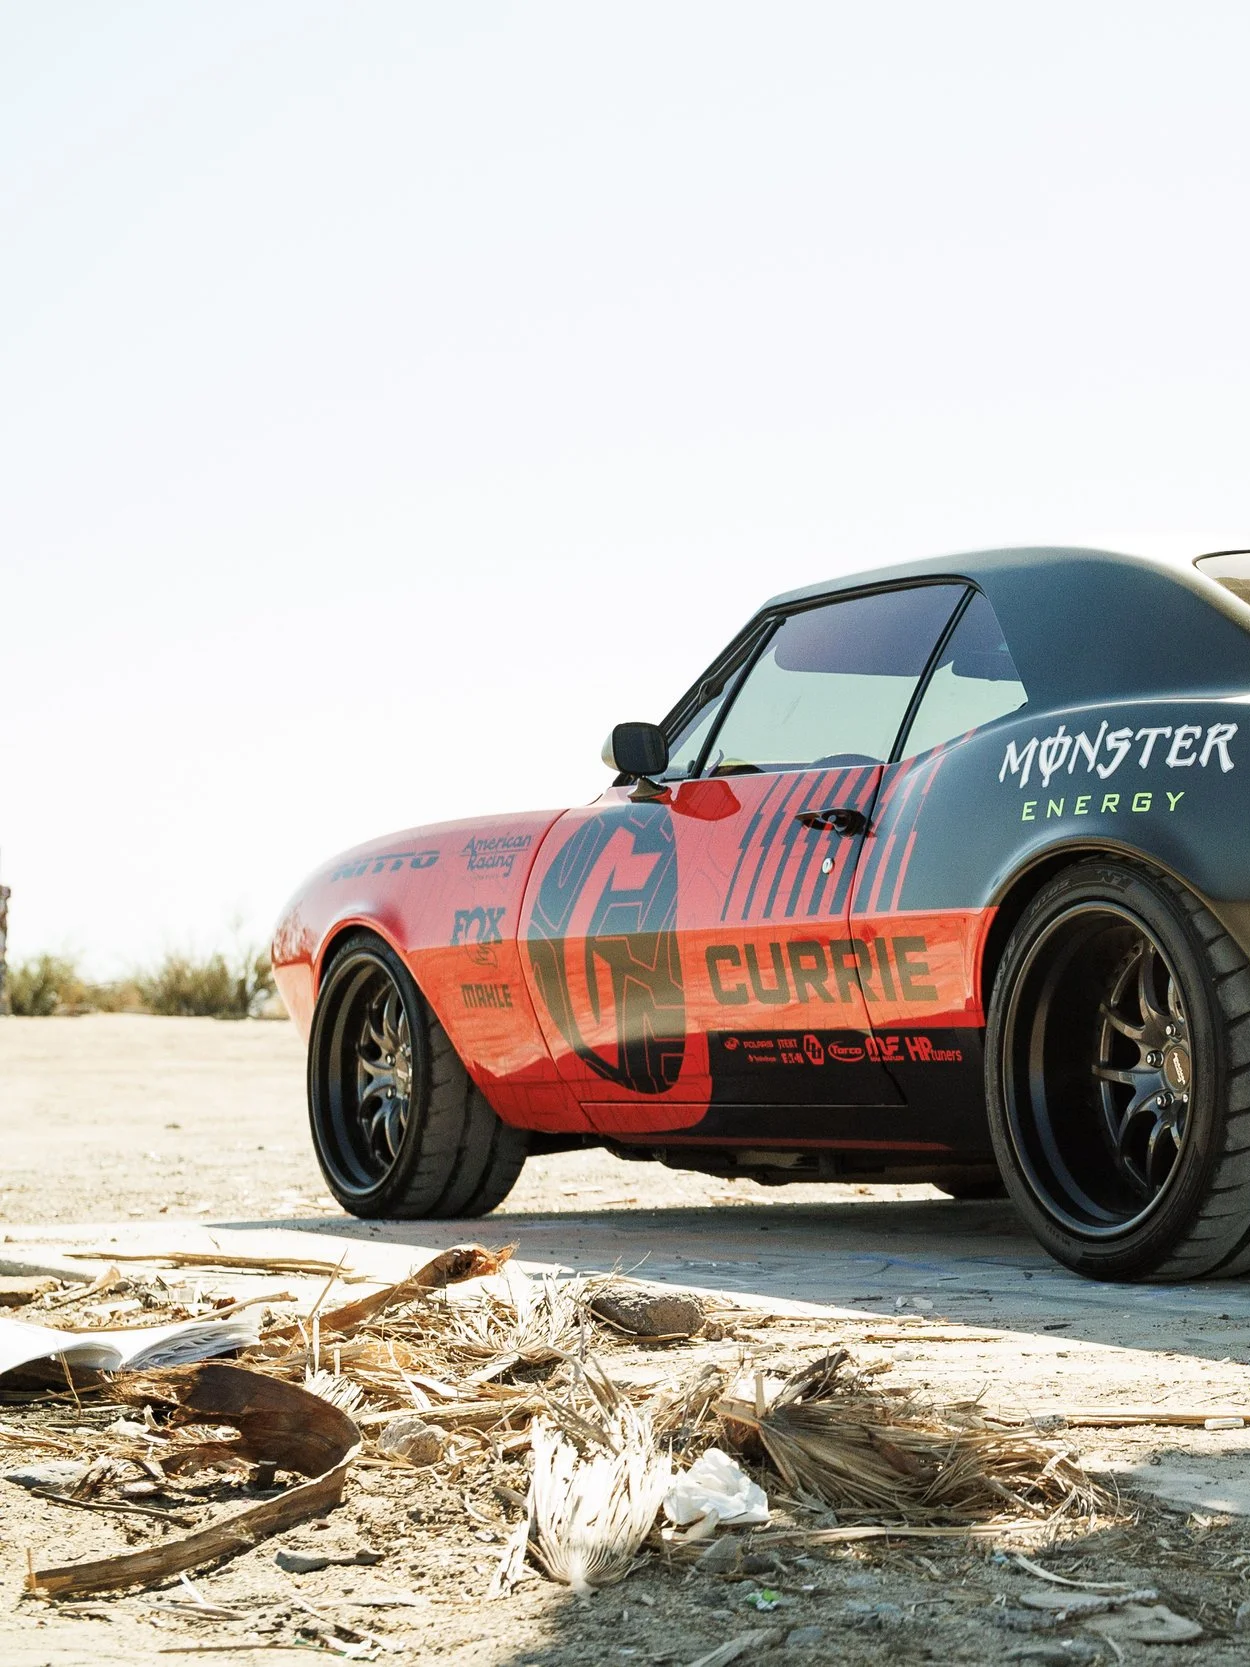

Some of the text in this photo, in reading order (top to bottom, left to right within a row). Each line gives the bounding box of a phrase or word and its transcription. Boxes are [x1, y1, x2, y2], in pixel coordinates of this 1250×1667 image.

[1021, 791, 1185, 821] ENERGY
[466, 833, 532, 852] American
[330, 850, 440, 882] NITTO
[467, 852, 517, 878] Racing
[452, 907, 506, 945] FOX
[705, 935, 938, 1005] CURRIE
[461, 984, 513, 1008] MAHLE
[743, 1040, 774, 1049] POLARIS
